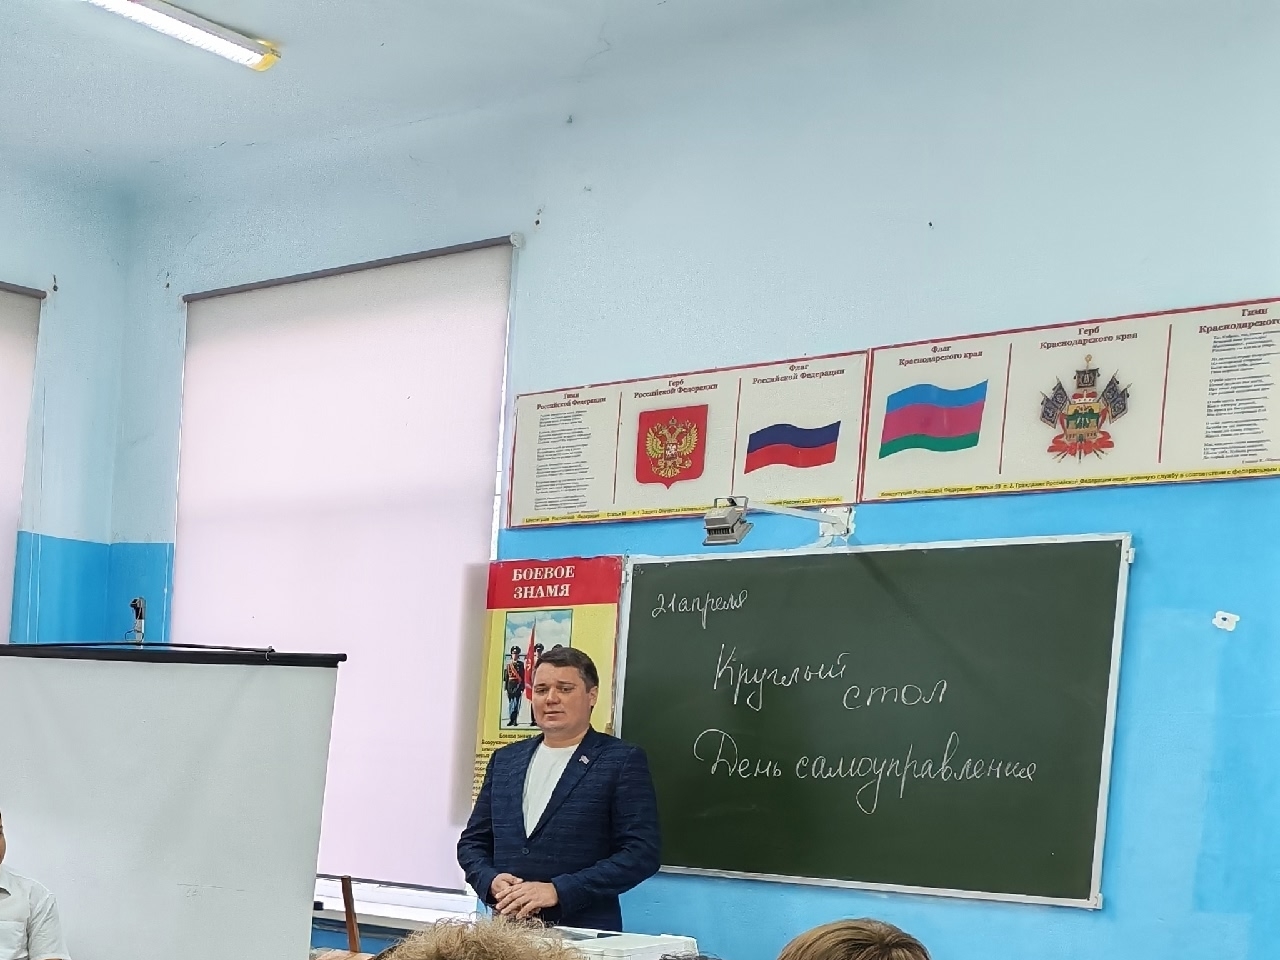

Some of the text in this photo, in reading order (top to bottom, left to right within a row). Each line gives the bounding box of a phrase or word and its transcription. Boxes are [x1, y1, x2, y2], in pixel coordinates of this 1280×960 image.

[1078, 326, 1100, 336] Герб
[1040, 332, 1138, 349] Краснодарского края
[899, 353, 962, 366] Краснодарского
[668, 379, 684, 387] Герб
[512, 566, 575, 581] БОЕВОЕ
[513, 584, 571, 599] ЗНАМЯ
[713, 643, 850, 711] Круглый
[843, 680, 948, 710] стол
[693, 729, 1037, 814] День самоуправления
